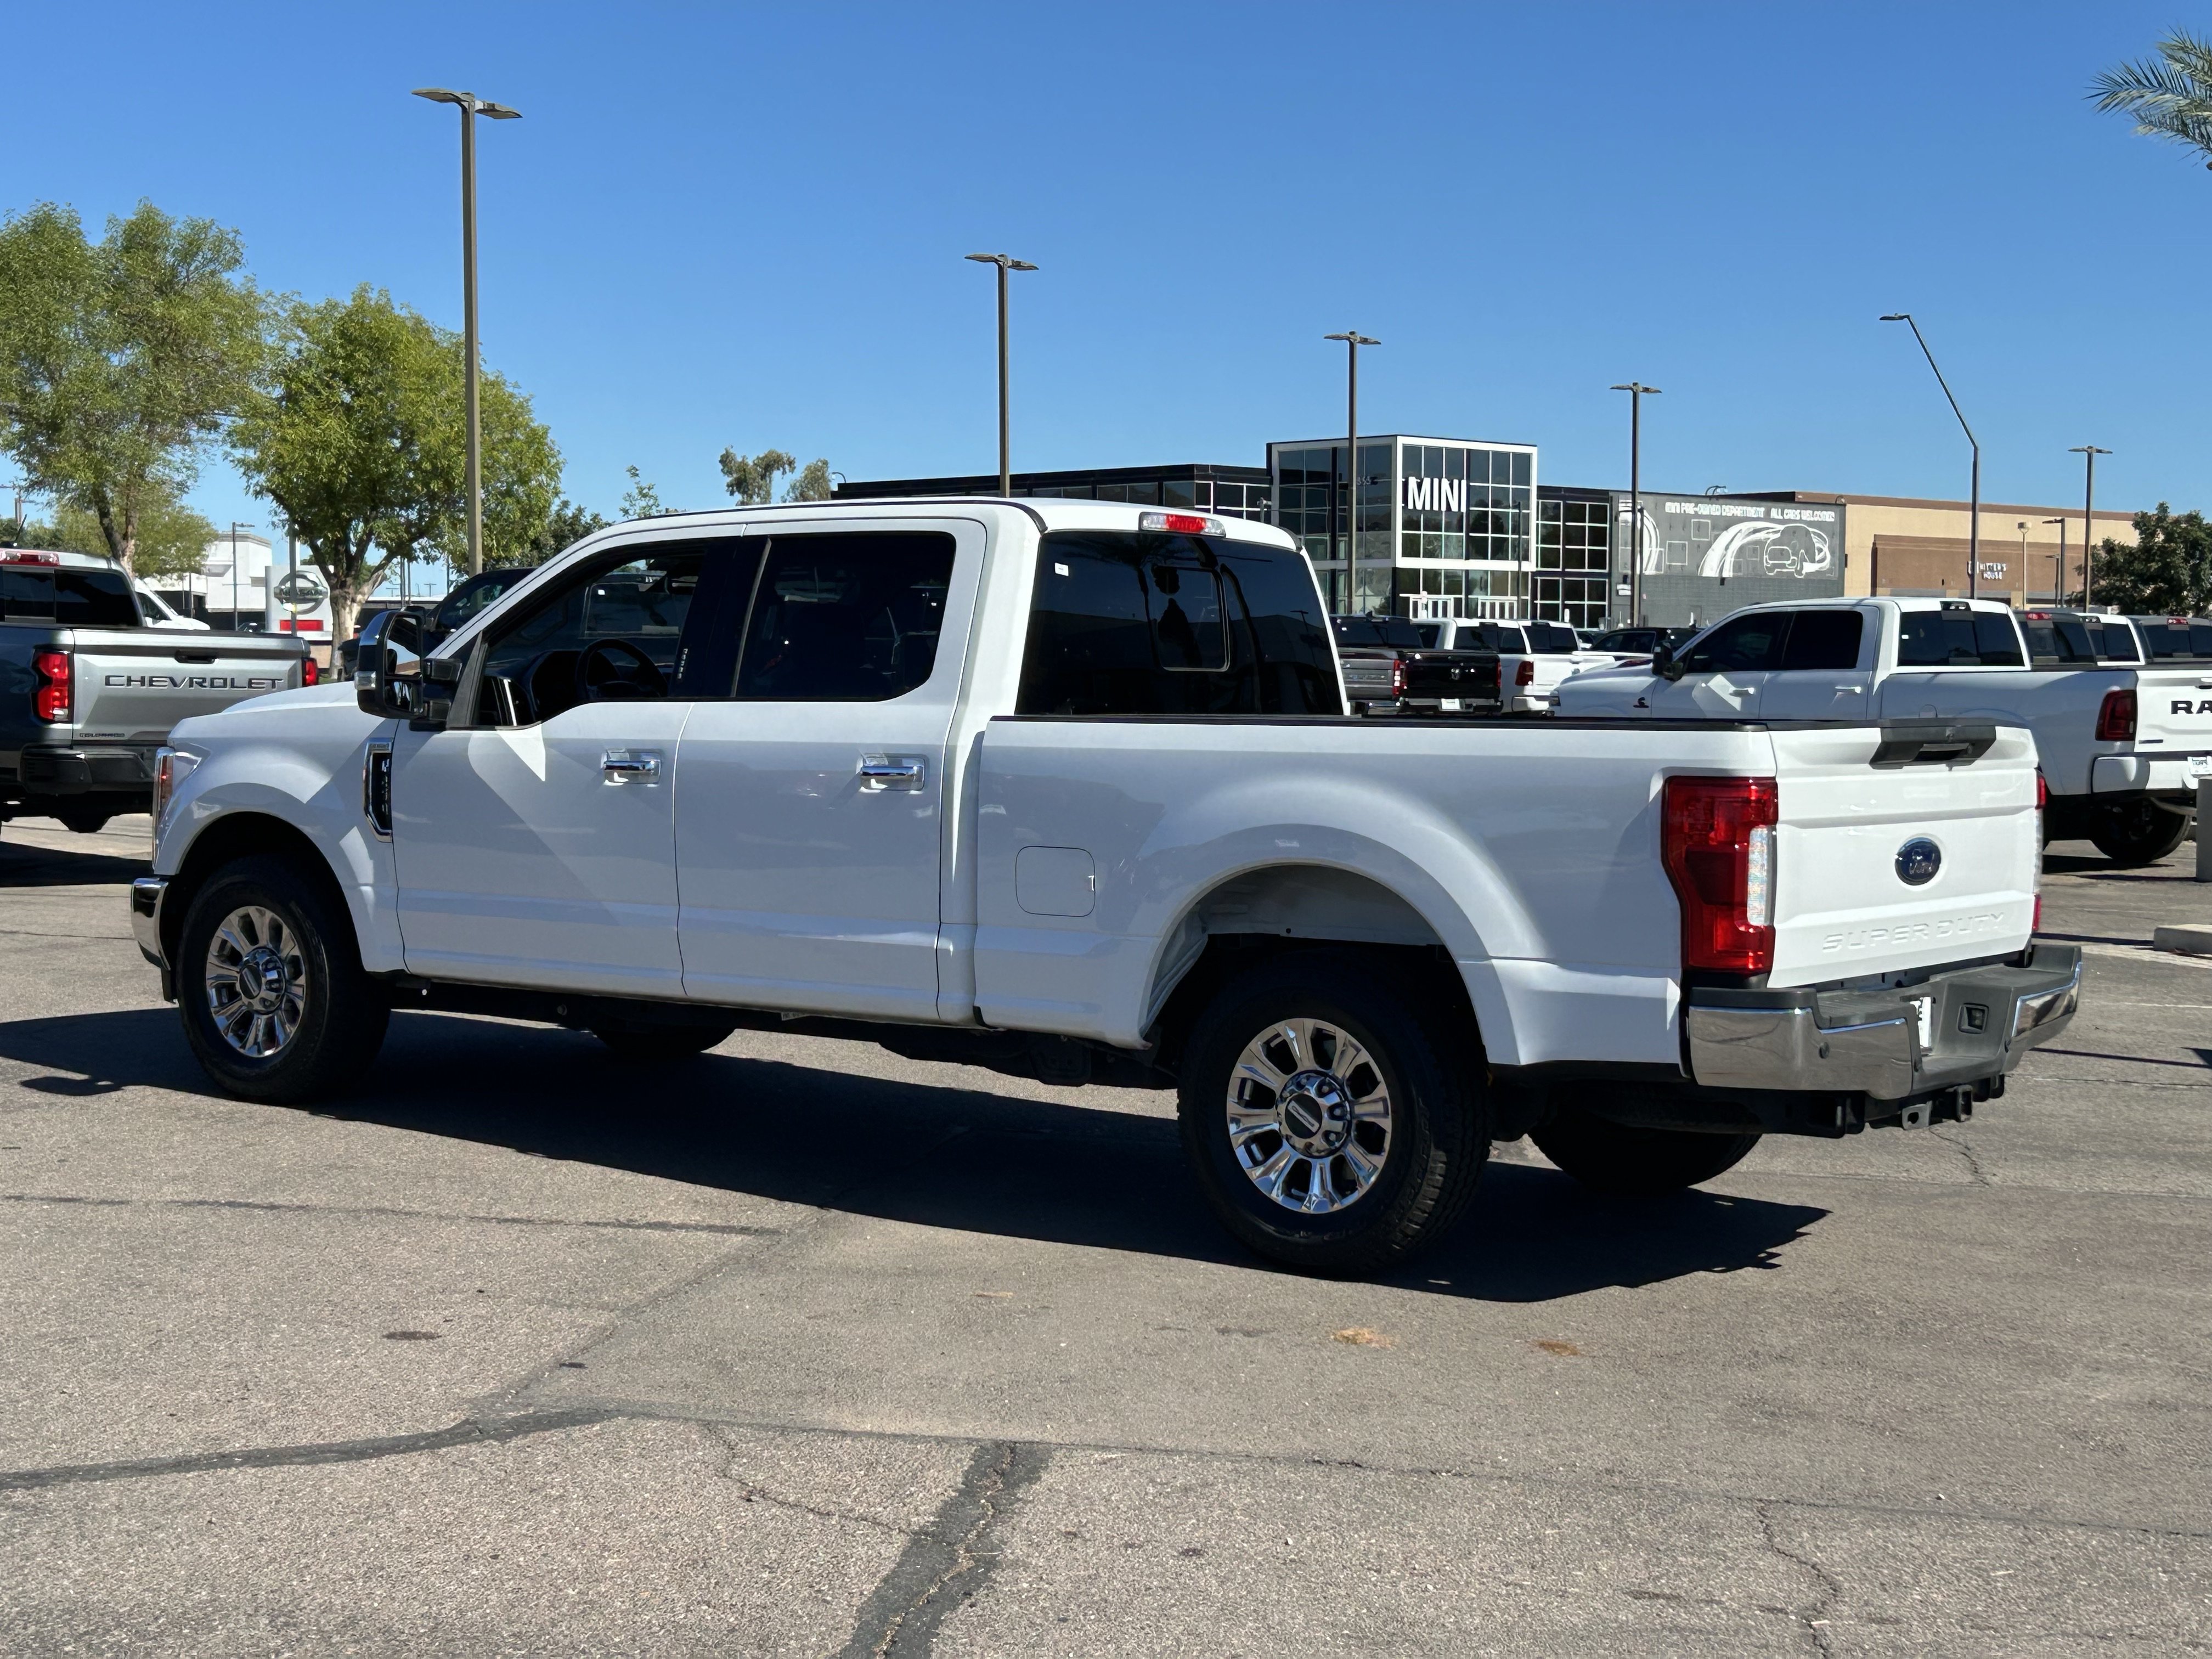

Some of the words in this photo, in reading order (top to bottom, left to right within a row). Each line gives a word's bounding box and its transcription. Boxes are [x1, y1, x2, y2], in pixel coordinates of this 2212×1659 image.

[1408, 476, 1466, 512] MINI
[105, 675, 284, 689] CHEVROLET
[1822, 924, 1929, 952] SUPER
[1937, 912, 2004, 938] DUTY
